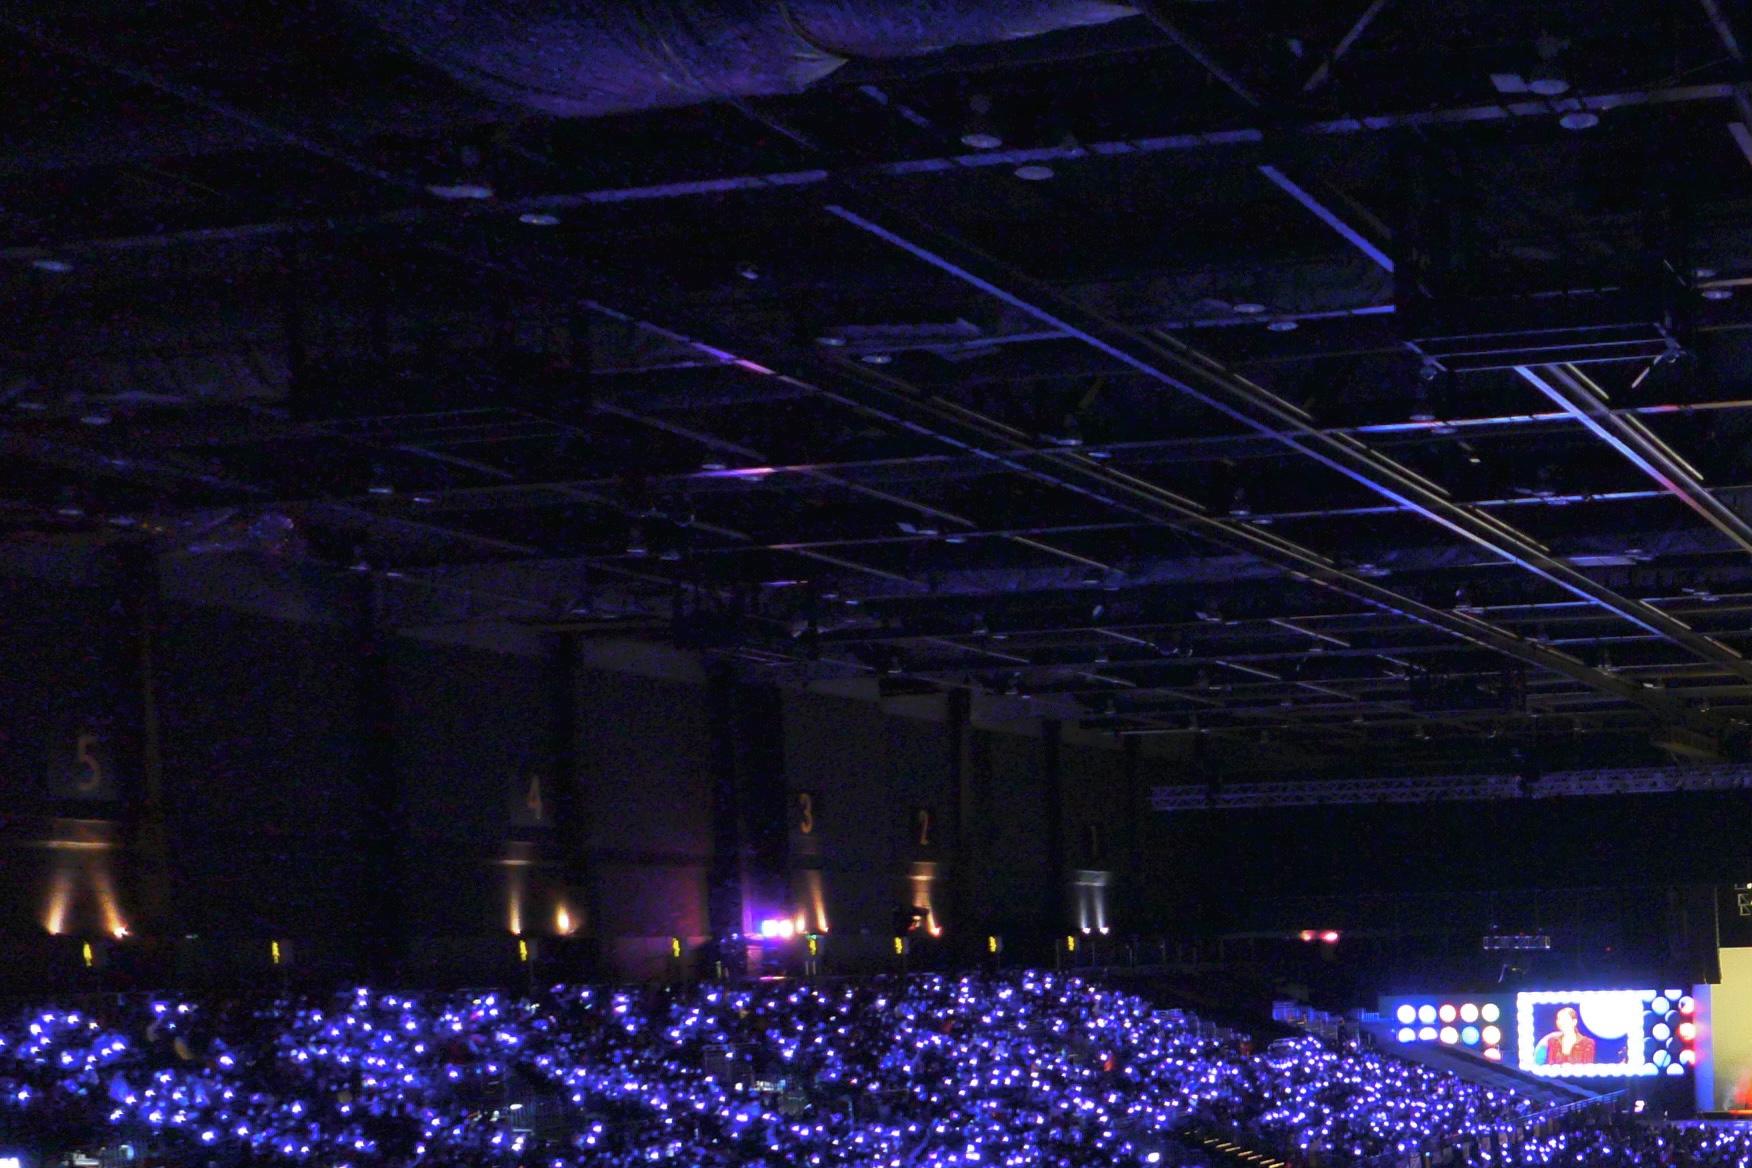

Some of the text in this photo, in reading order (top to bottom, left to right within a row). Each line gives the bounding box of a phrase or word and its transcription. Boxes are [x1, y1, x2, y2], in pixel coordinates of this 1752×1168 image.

[77, 735, 101, 792] 5
[527, 775, 543, 820] 4
[799, 792, 813, 834] 3
[919, 809, 930, 846] 2
